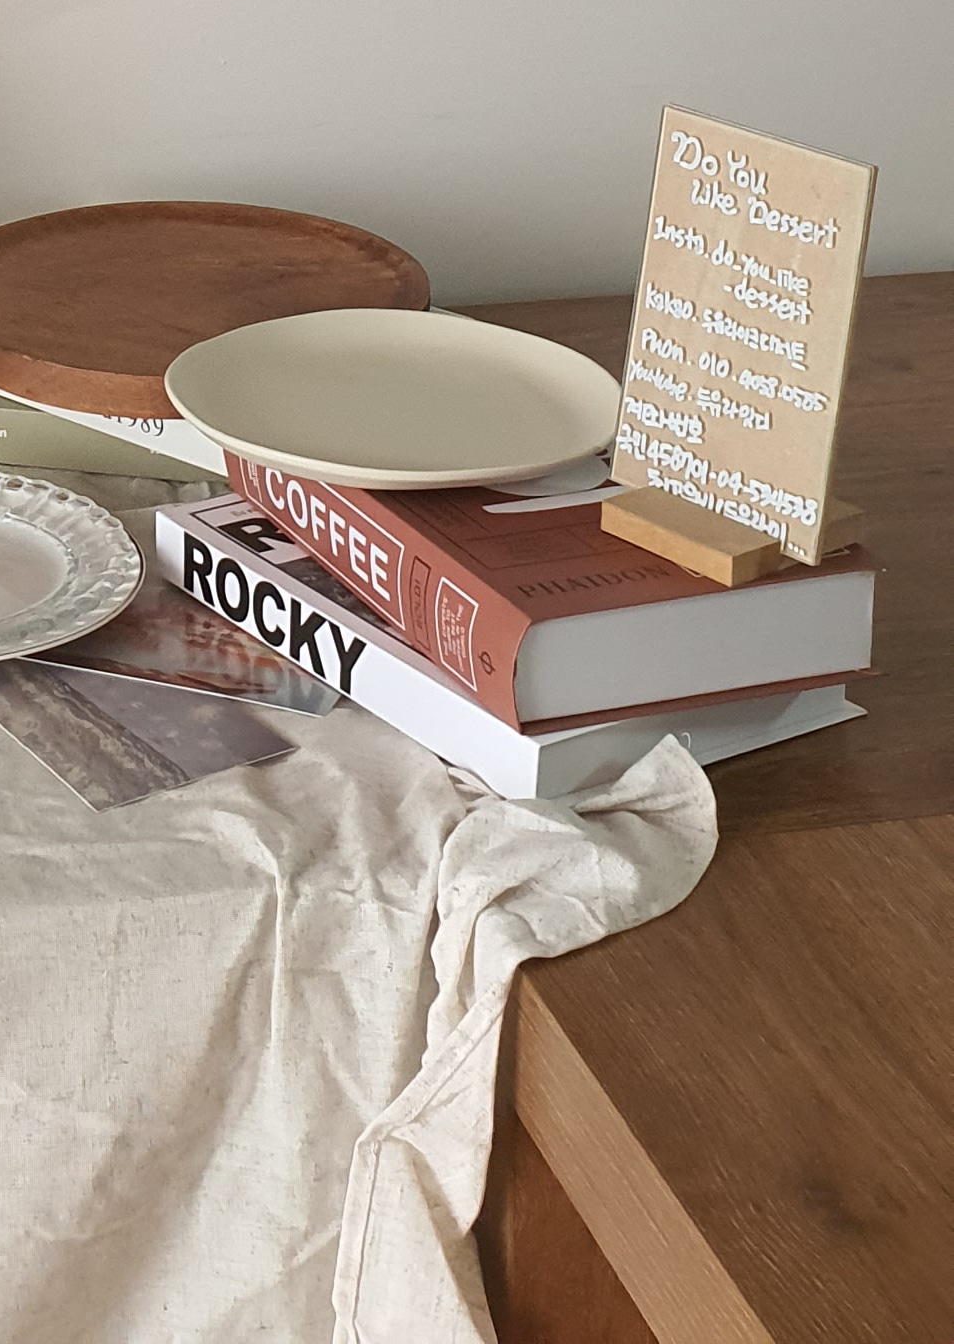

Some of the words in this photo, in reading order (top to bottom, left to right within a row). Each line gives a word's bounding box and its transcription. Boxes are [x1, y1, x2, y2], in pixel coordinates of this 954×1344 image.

[670, 130, 719, 177] Do
[726, 149, 769, 196] You
[747, 195, 839, 250] Dessert
[265, 467, 392, 604] COFFEE
[182, 531, 368, 698] ROCKY
[516, 565, 672, 599] PHAIDON
